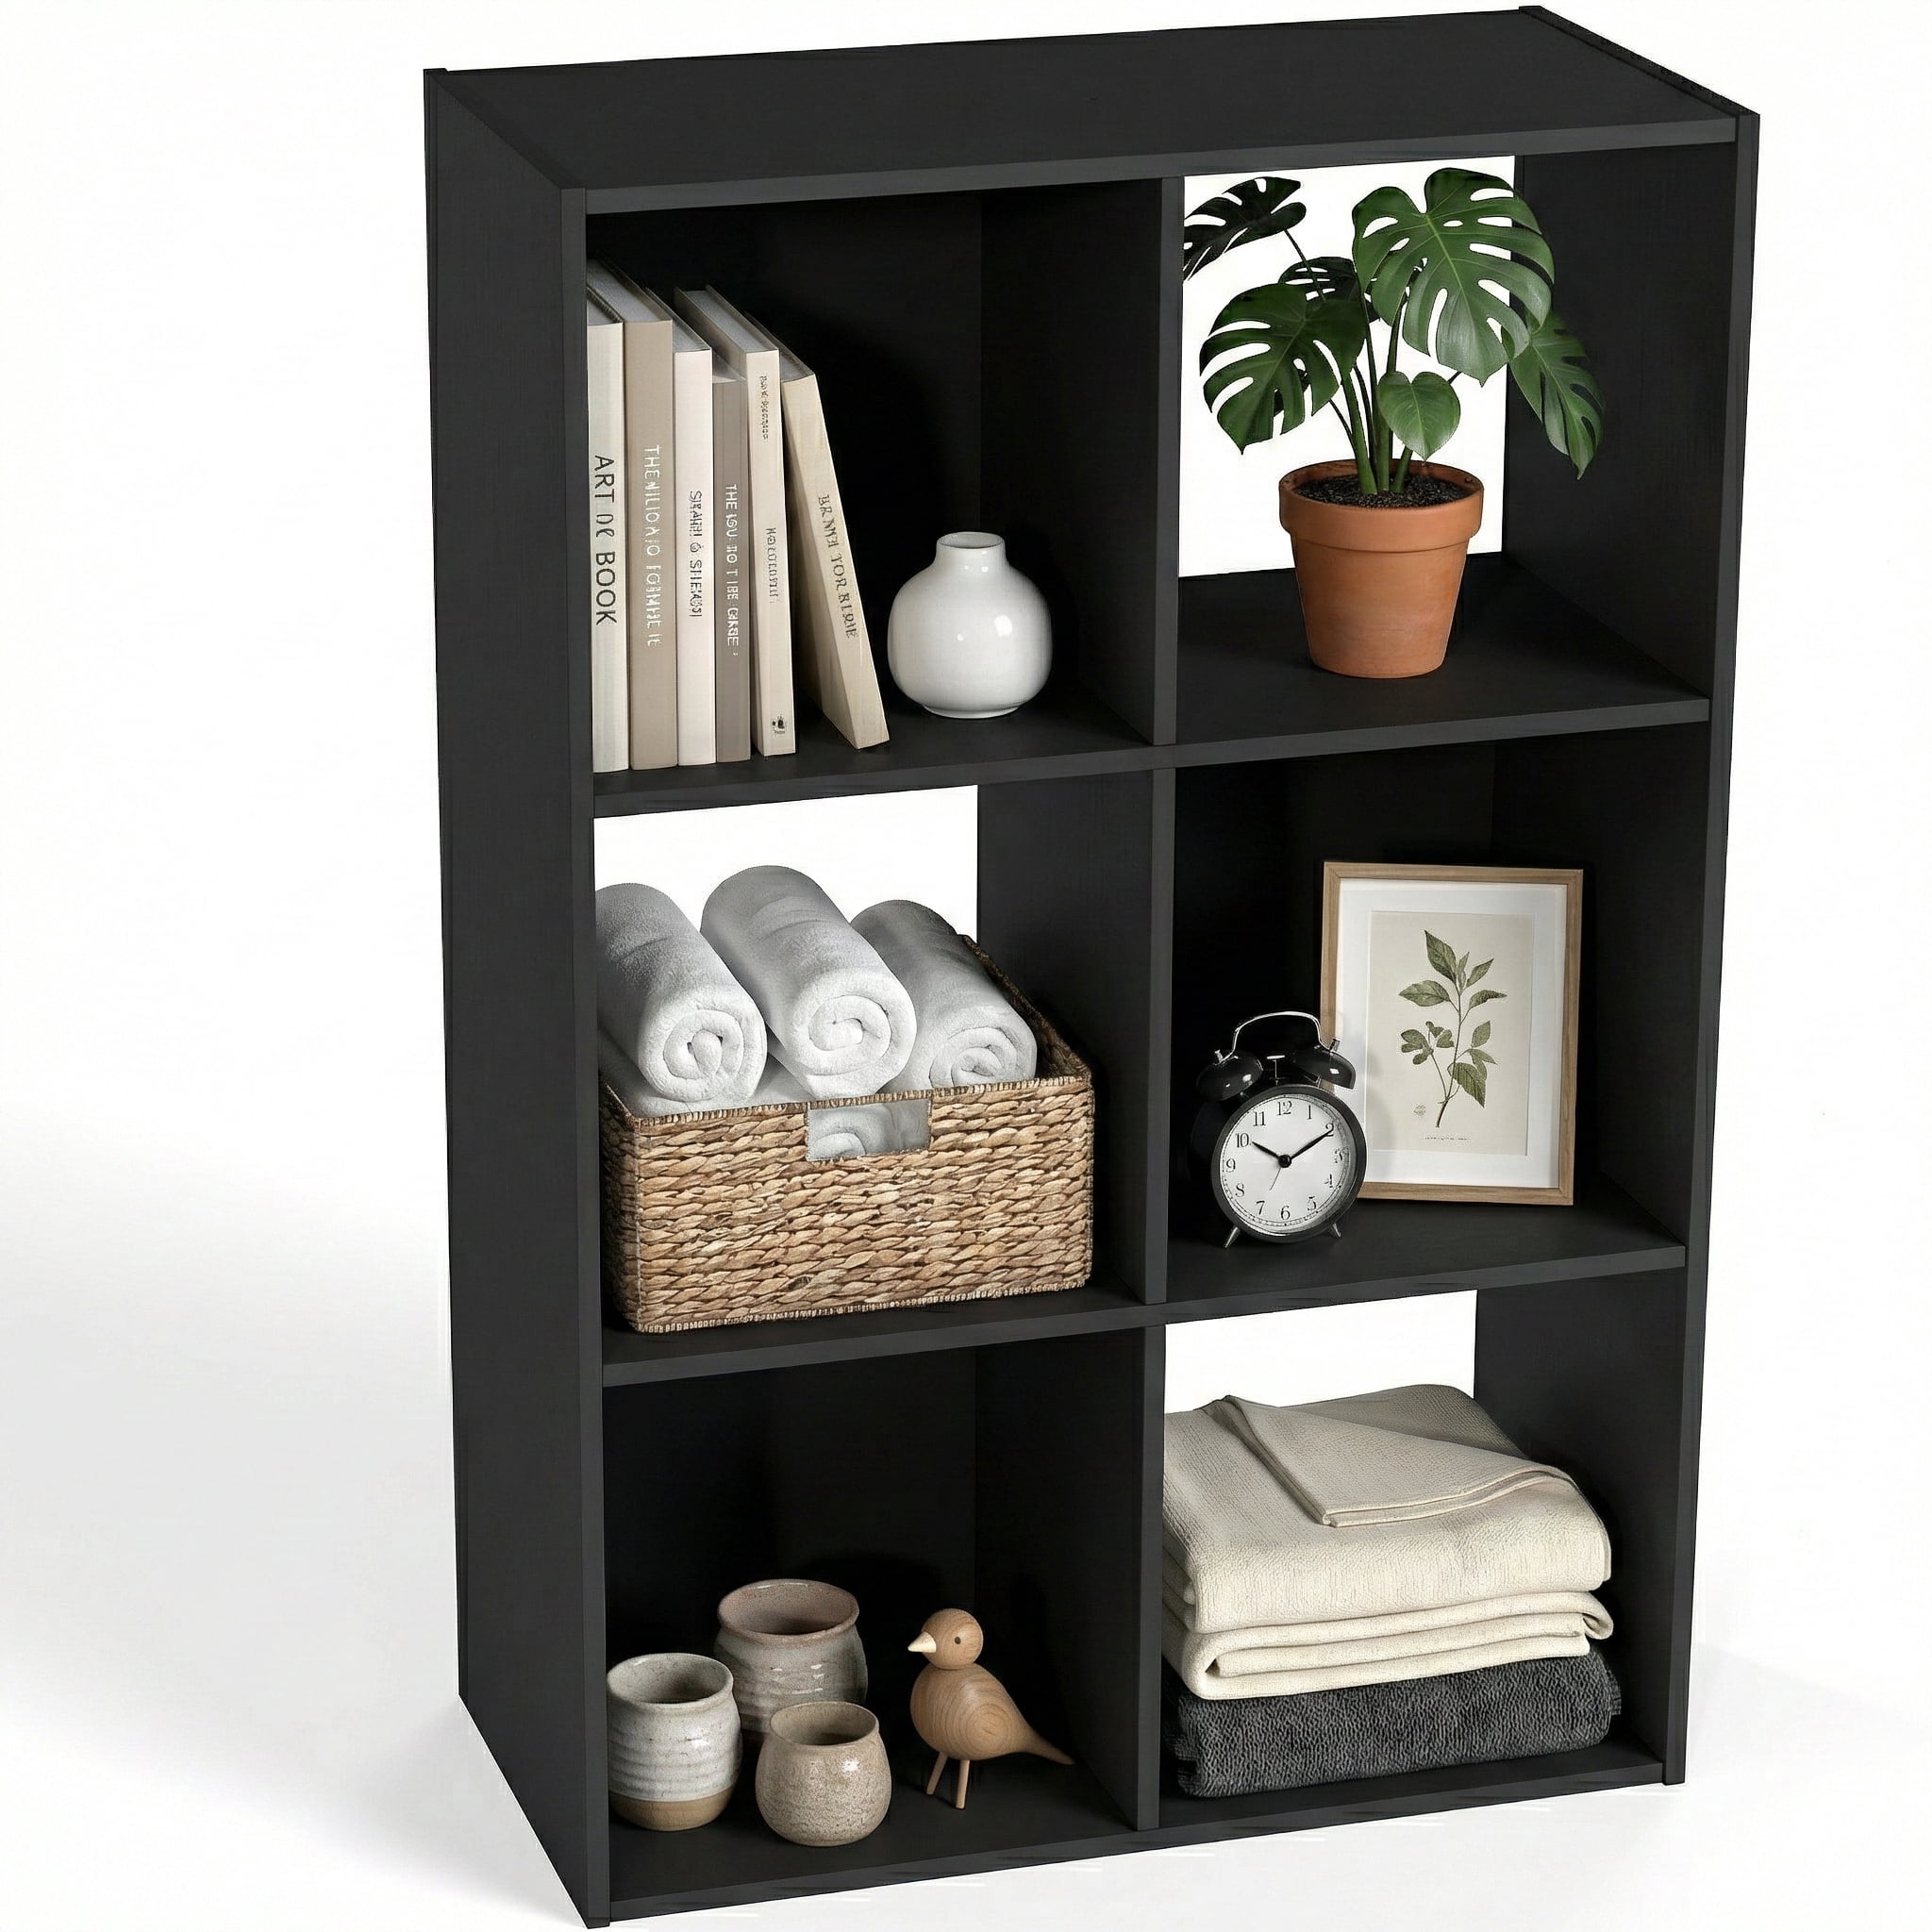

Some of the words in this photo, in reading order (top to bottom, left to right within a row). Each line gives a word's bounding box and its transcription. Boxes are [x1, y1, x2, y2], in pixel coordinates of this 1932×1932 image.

[594, 455, 615, 503] ART
[595, 551, 617, 625] BOOK
[1275, 1100, 1292, 1116] 12
[1307, 1104, 1312, 1120] 1
[1253, 1111, 1266, 1126] 11
[1324, 1123, 1335, 1137] 2
[1235, 1133, 1250, 1148] 10
[1225, 1158, 1236, 1173] 9
[1256, 1200, 1265, 1215] 7
[1280, 1205, 1291, 1221] 6
